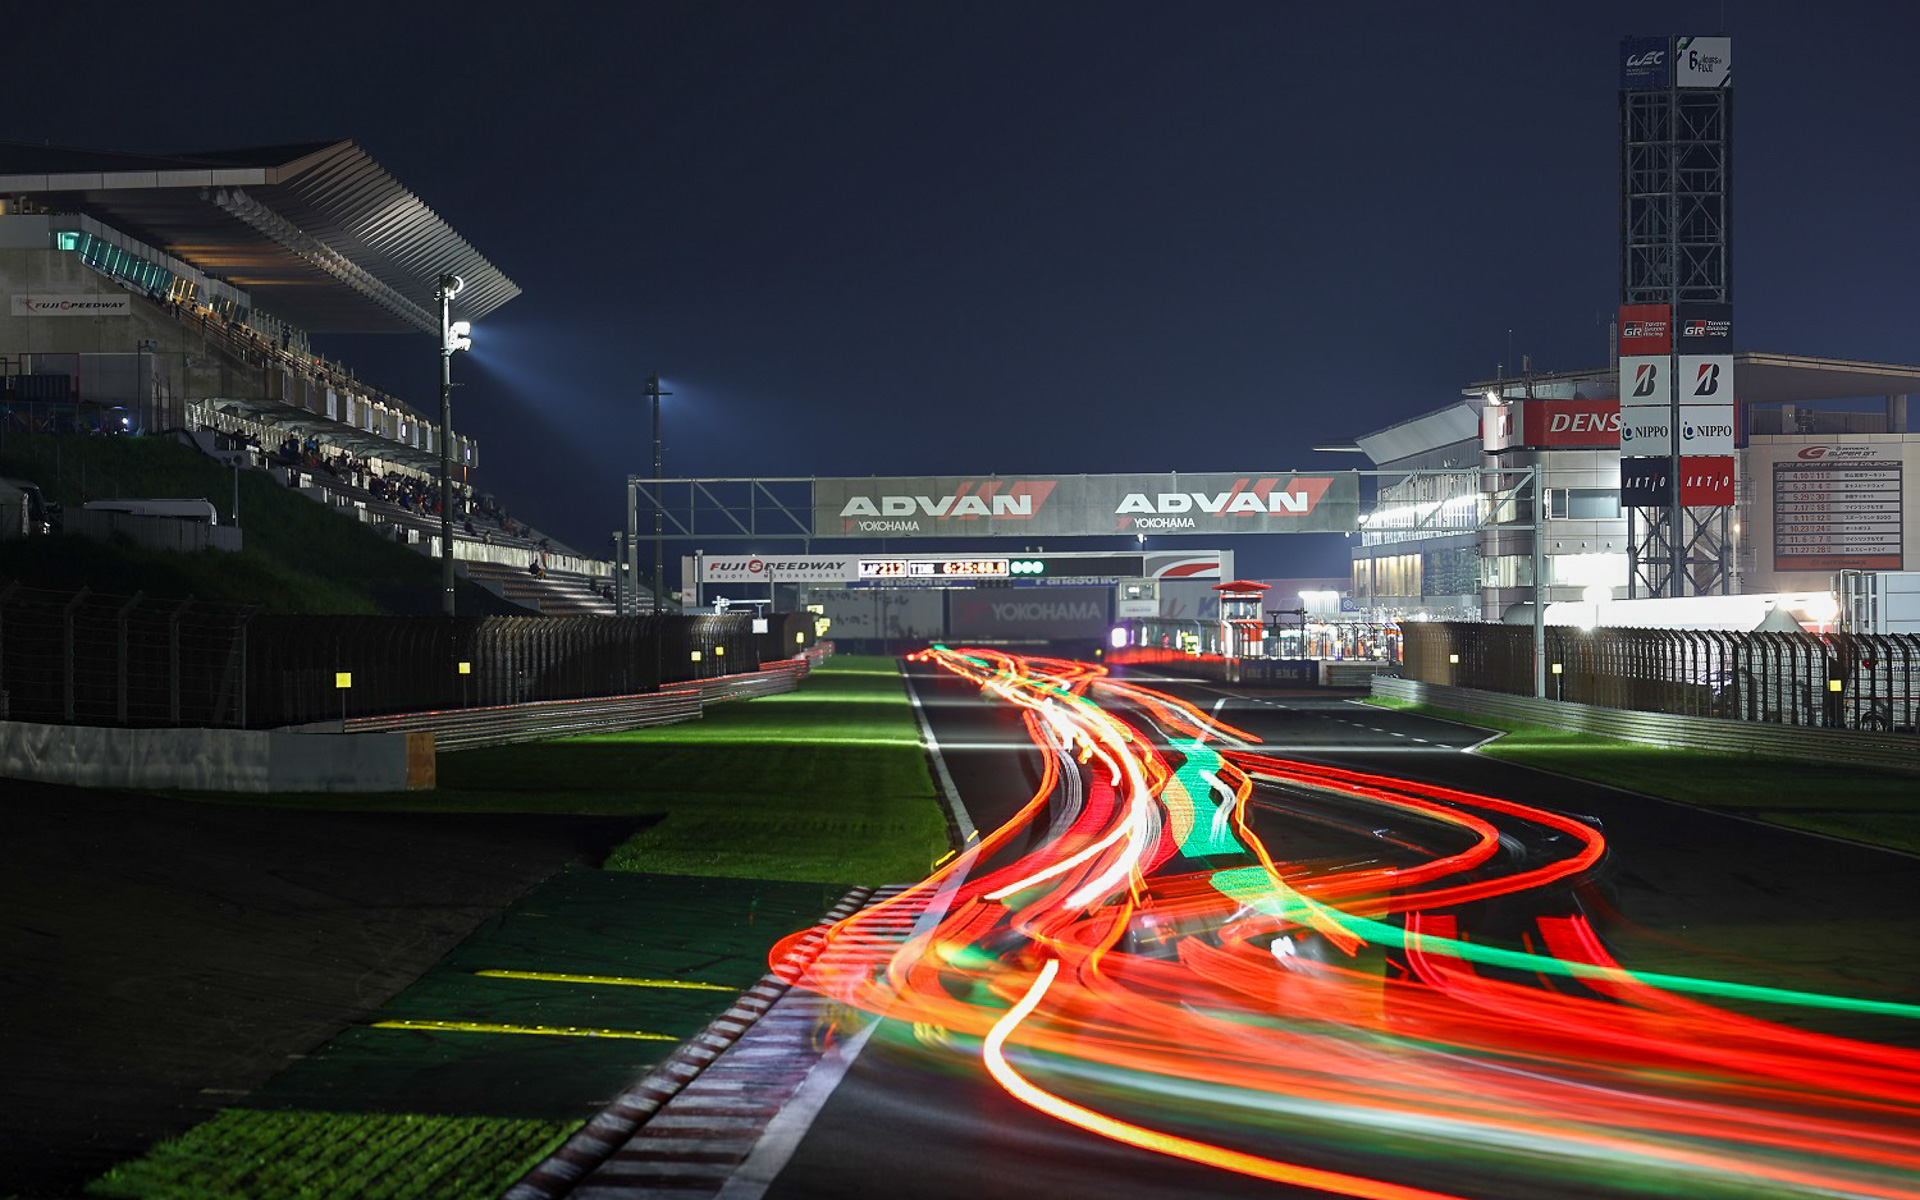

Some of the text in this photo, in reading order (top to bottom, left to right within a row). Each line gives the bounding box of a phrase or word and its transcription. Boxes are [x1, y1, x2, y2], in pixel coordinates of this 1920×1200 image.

[1626, 51, 1665, 67] WEC
[1689, 50, 1698, 71] 6
[1624, 328, 1642, 336] GR
[1685, 327, 1705, 335] GR
[1550, 412, 1621, 433] DENS
[1635, 425, 1668, 438] NIPPO
[1697, 424, 1732, 437] NIPPO
[839, 494, 1032, 517] ADVAN
[1114, 491, 1308, 514] ADVAN
[858, 521, 920, 532] YOKOHAMA
[1134, 517, 1195, 528] YOKOHAMA
[709, 562, 746, 571] FUJI
[991, 603, 1101, 620] YOKOHAMA
